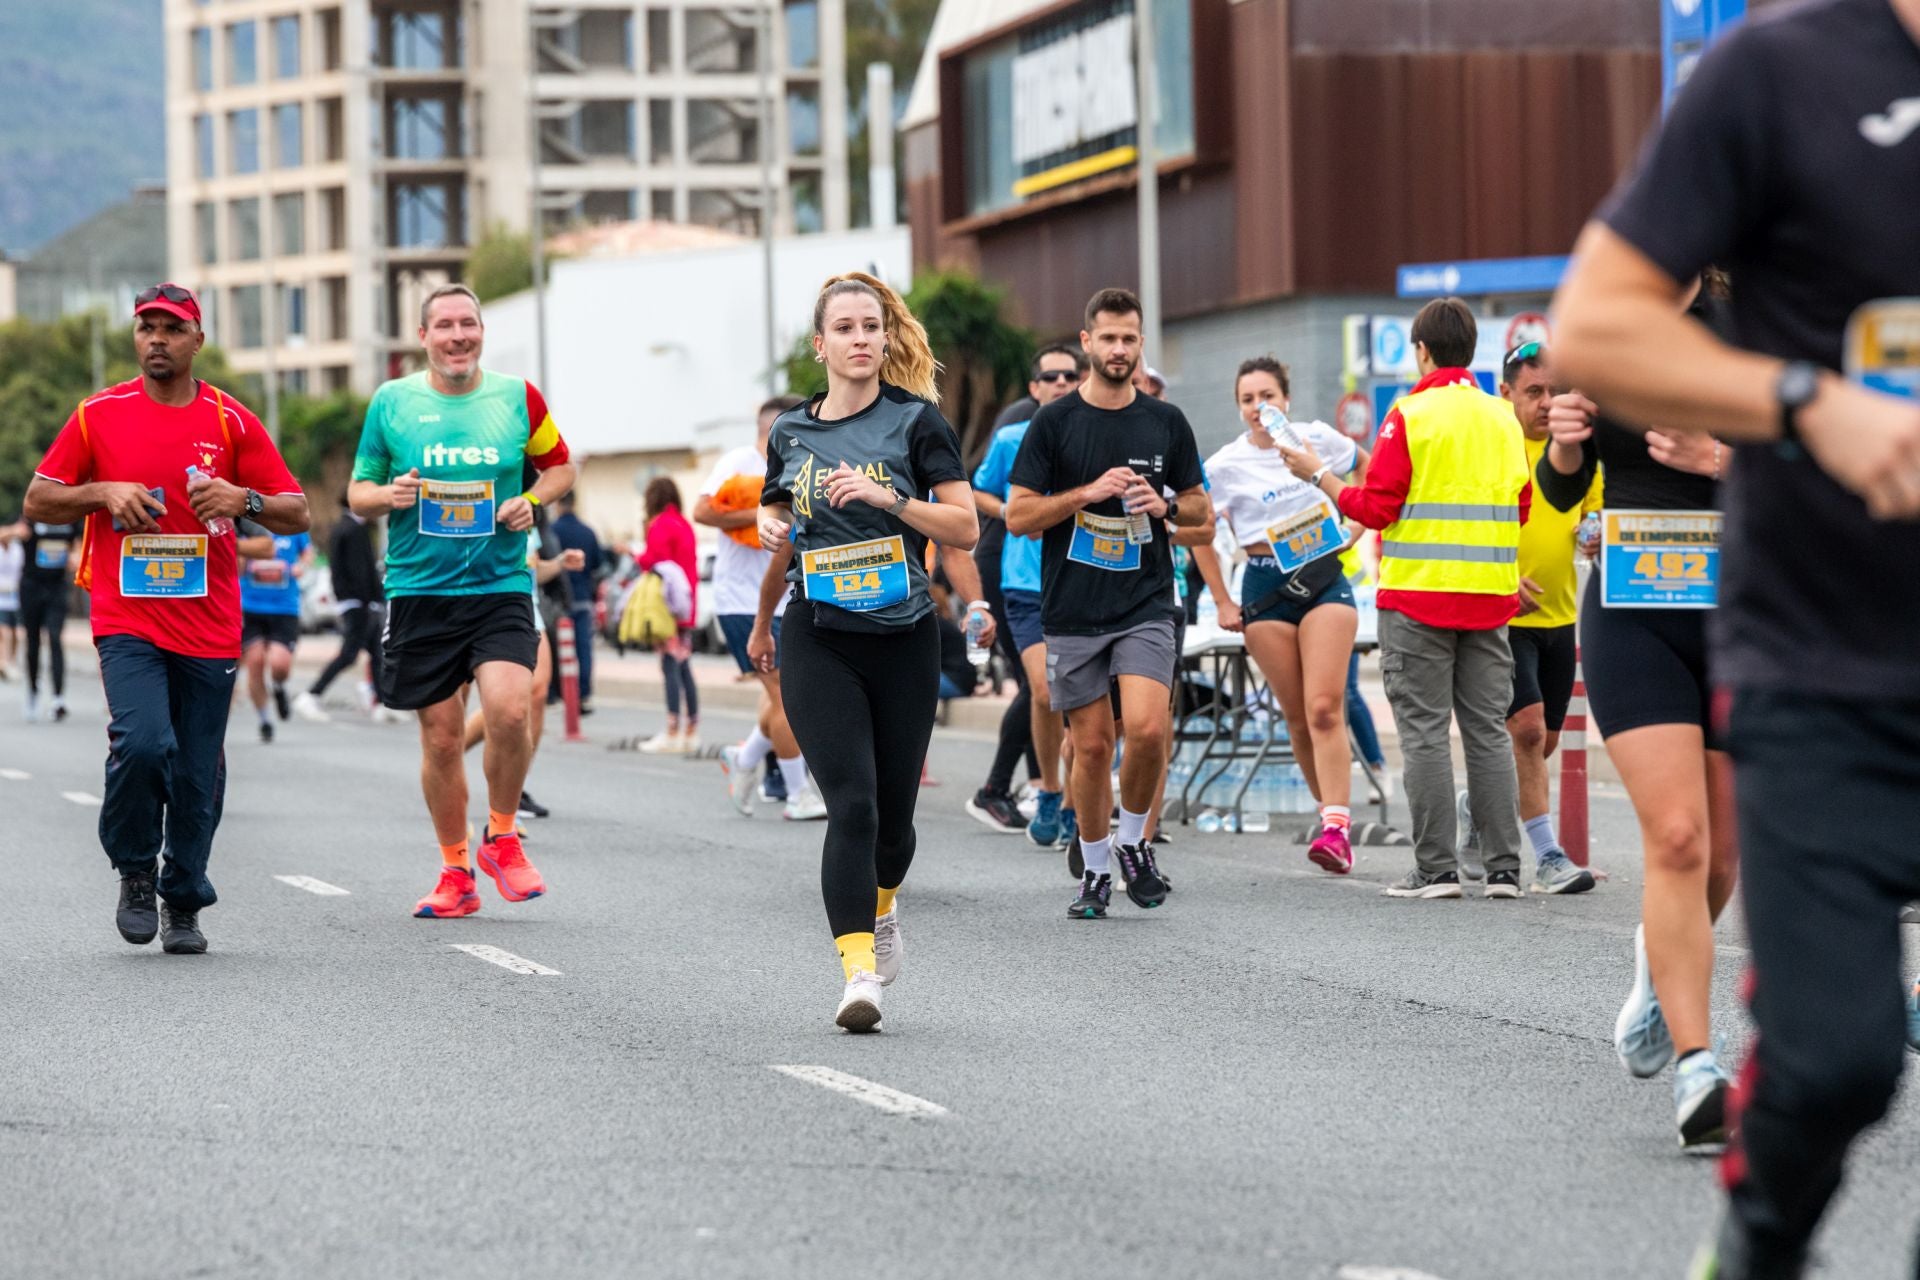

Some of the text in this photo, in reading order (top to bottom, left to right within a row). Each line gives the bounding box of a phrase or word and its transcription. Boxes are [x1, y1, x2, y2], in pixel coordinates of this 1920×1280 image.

[440, 505, 475, 521] 710
[144, 547, 197, 555] EMPRESAS
[829, 542, 893, 562] CARRERA
[1093, 537, 1126, 555] 183
[144, 561, 185, 579] 415
[816, 562, 830, 571] DE
[832, 553, 893, 569] EMPRESAS
[1634, 552, 1708, 579] 492
[833, 571, 882, 593] 134
